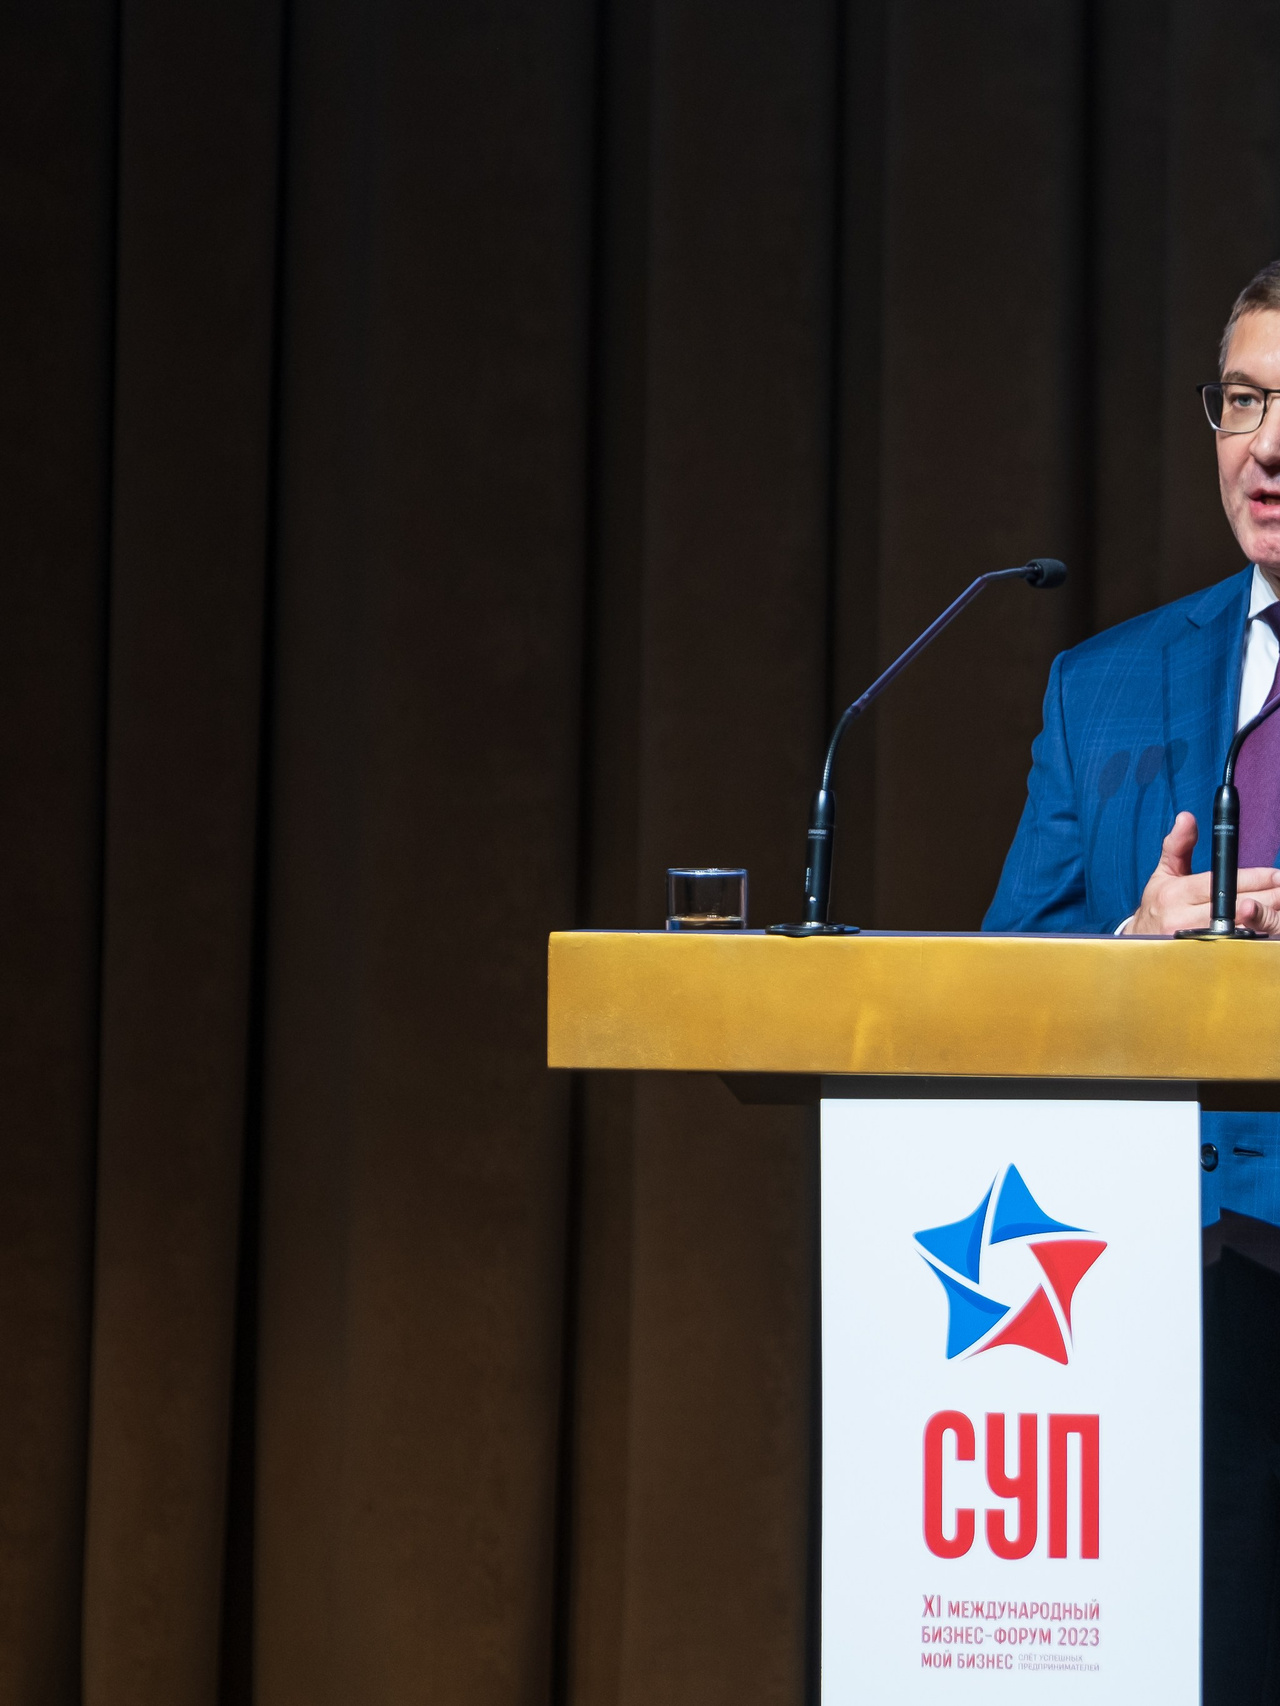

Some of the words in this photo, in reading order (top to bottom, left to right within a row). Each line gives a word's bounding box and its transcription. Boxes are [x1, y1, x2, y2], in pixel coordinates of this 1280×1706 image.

[923, 1409, 1100, 1560] СУП
[921, 1594, 941, 1618] XI
[947, 1598, 1100, 1621] МЕЖДУНАРОДНЫЙ
[921, 1626, 1052, 1646] БИЗНЕС-ФОРУМ
[1057, 1627, 1100, 1647] 2023
[921, 1649, 952, 1669] МОЙ
[957, 1652, 1013, 1670] БИЗНЕС
[1018, 1662, 1100, 1672] ПРЕДПРИНИМАТЕЛЕЙ
